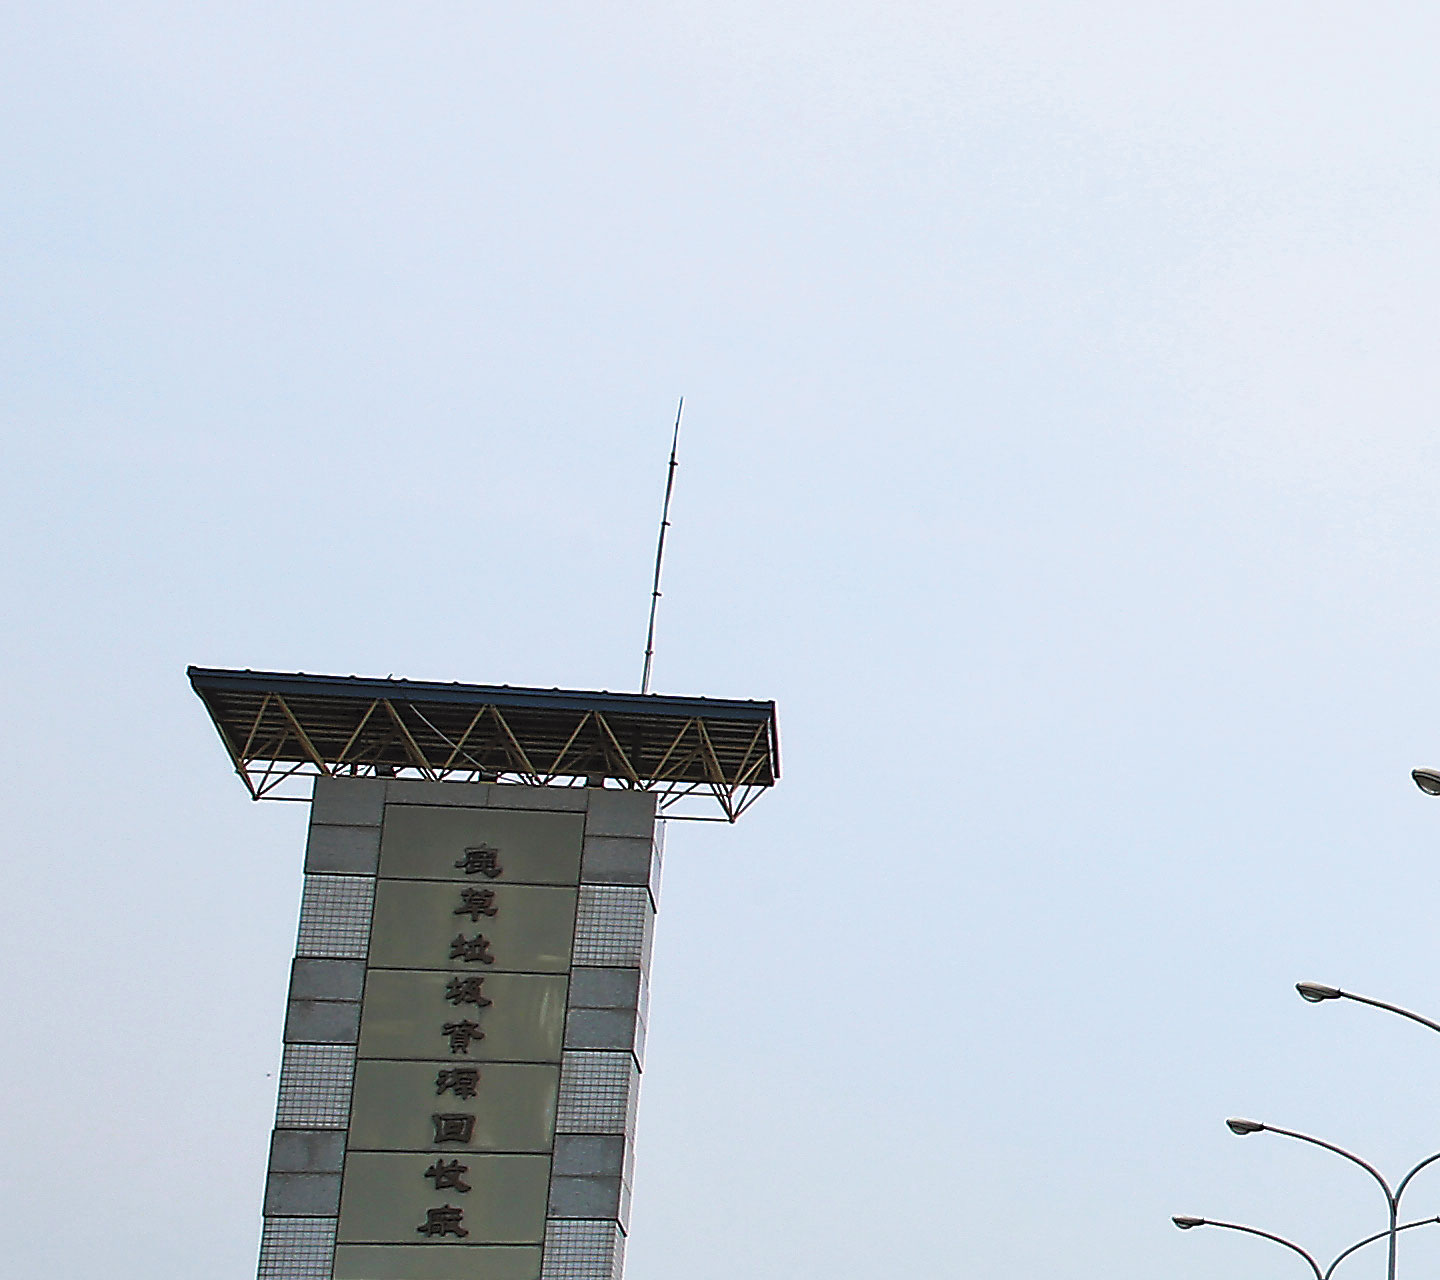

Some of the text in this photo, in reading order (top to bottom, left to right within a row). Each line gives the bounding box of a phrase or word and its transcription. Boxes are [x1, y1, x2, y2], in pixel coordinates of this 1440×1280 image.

[416, 841, 503, 1238] 鹿草垃圾資源回收廠
